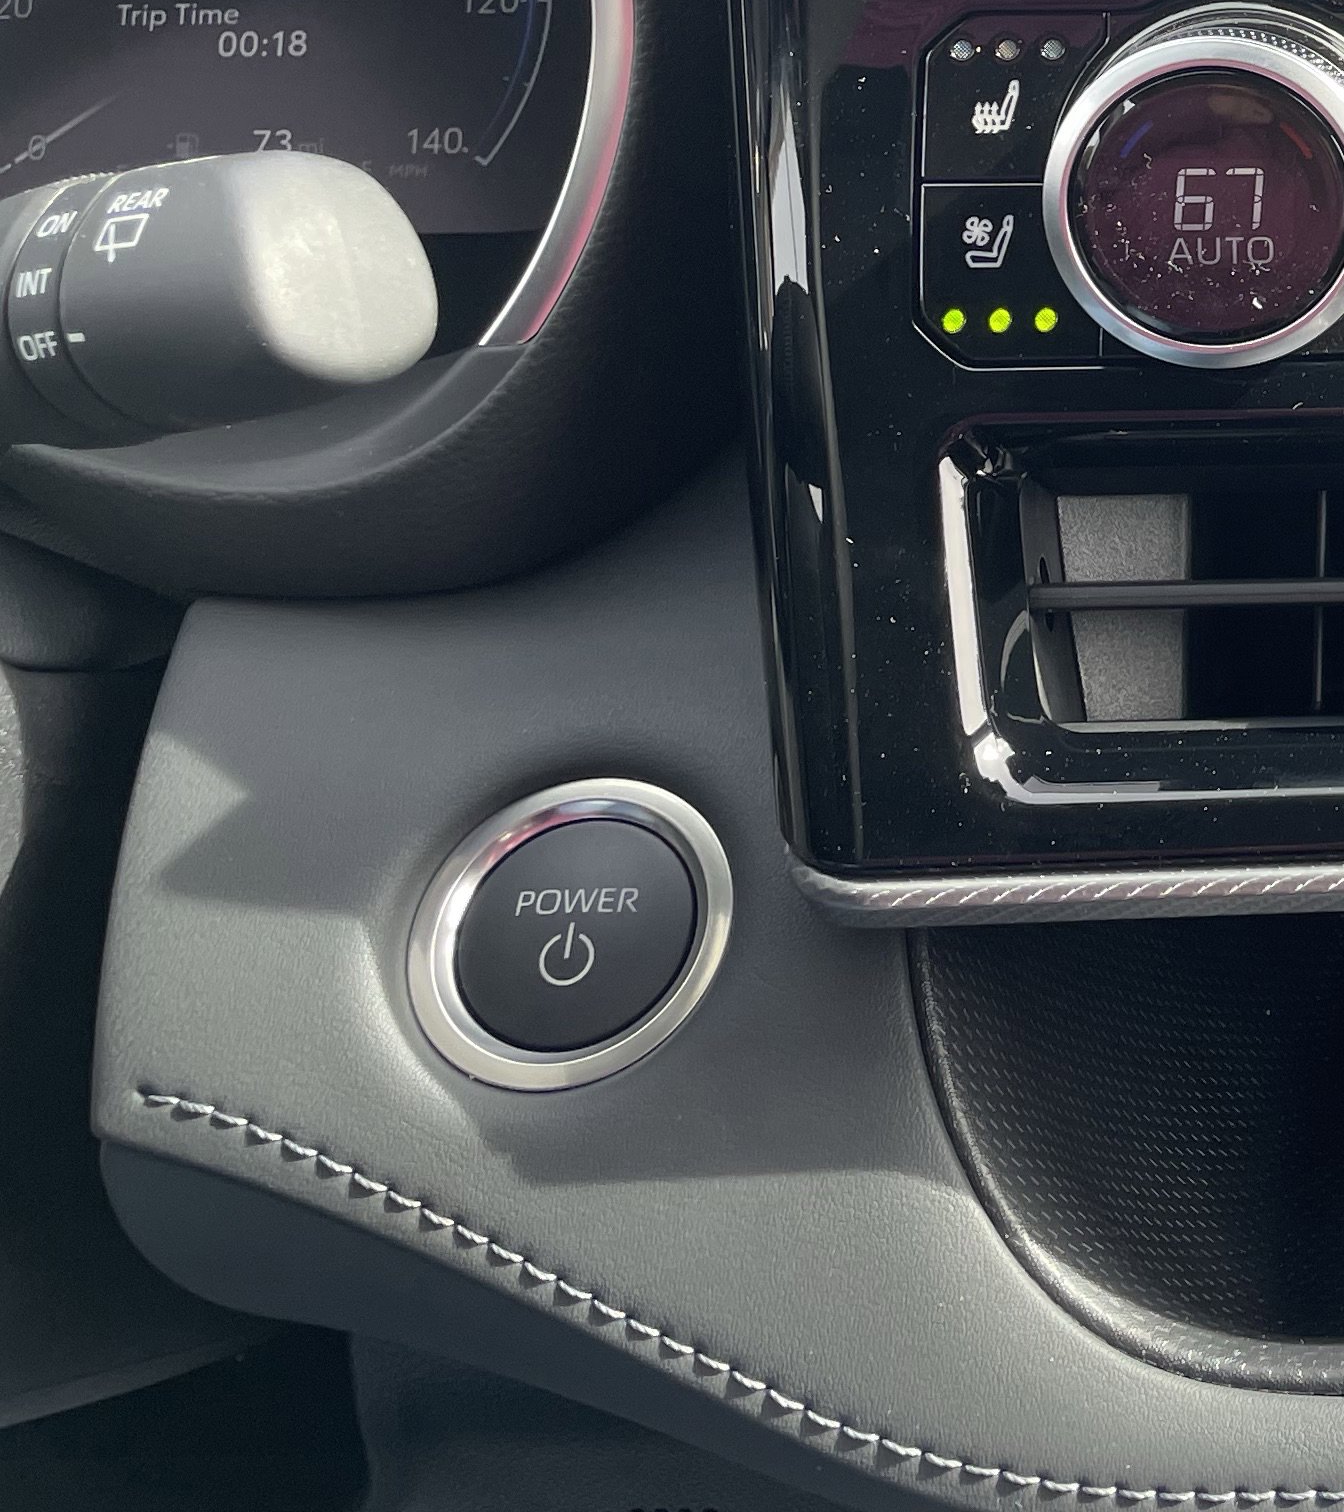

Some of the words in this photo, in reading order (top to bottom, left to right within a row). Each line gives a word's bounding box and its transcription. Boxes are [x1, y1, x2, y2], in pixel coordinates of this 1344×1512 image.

[118, 4, 166, 28] Trip
[177, 4, 239, 26] Time
[218, 31, 307, 57] 00:18
[107, 188, 169, 213] REAR
[1173, 168, 1266, 231] 67
[36, 211, 77, 237] ON
[1168, 236, 1274, 267] AUTO
[16, 268, 52, 297] INT
[18, 331, 58, 362] OFF
[515, 888, 639, 917] POWER
